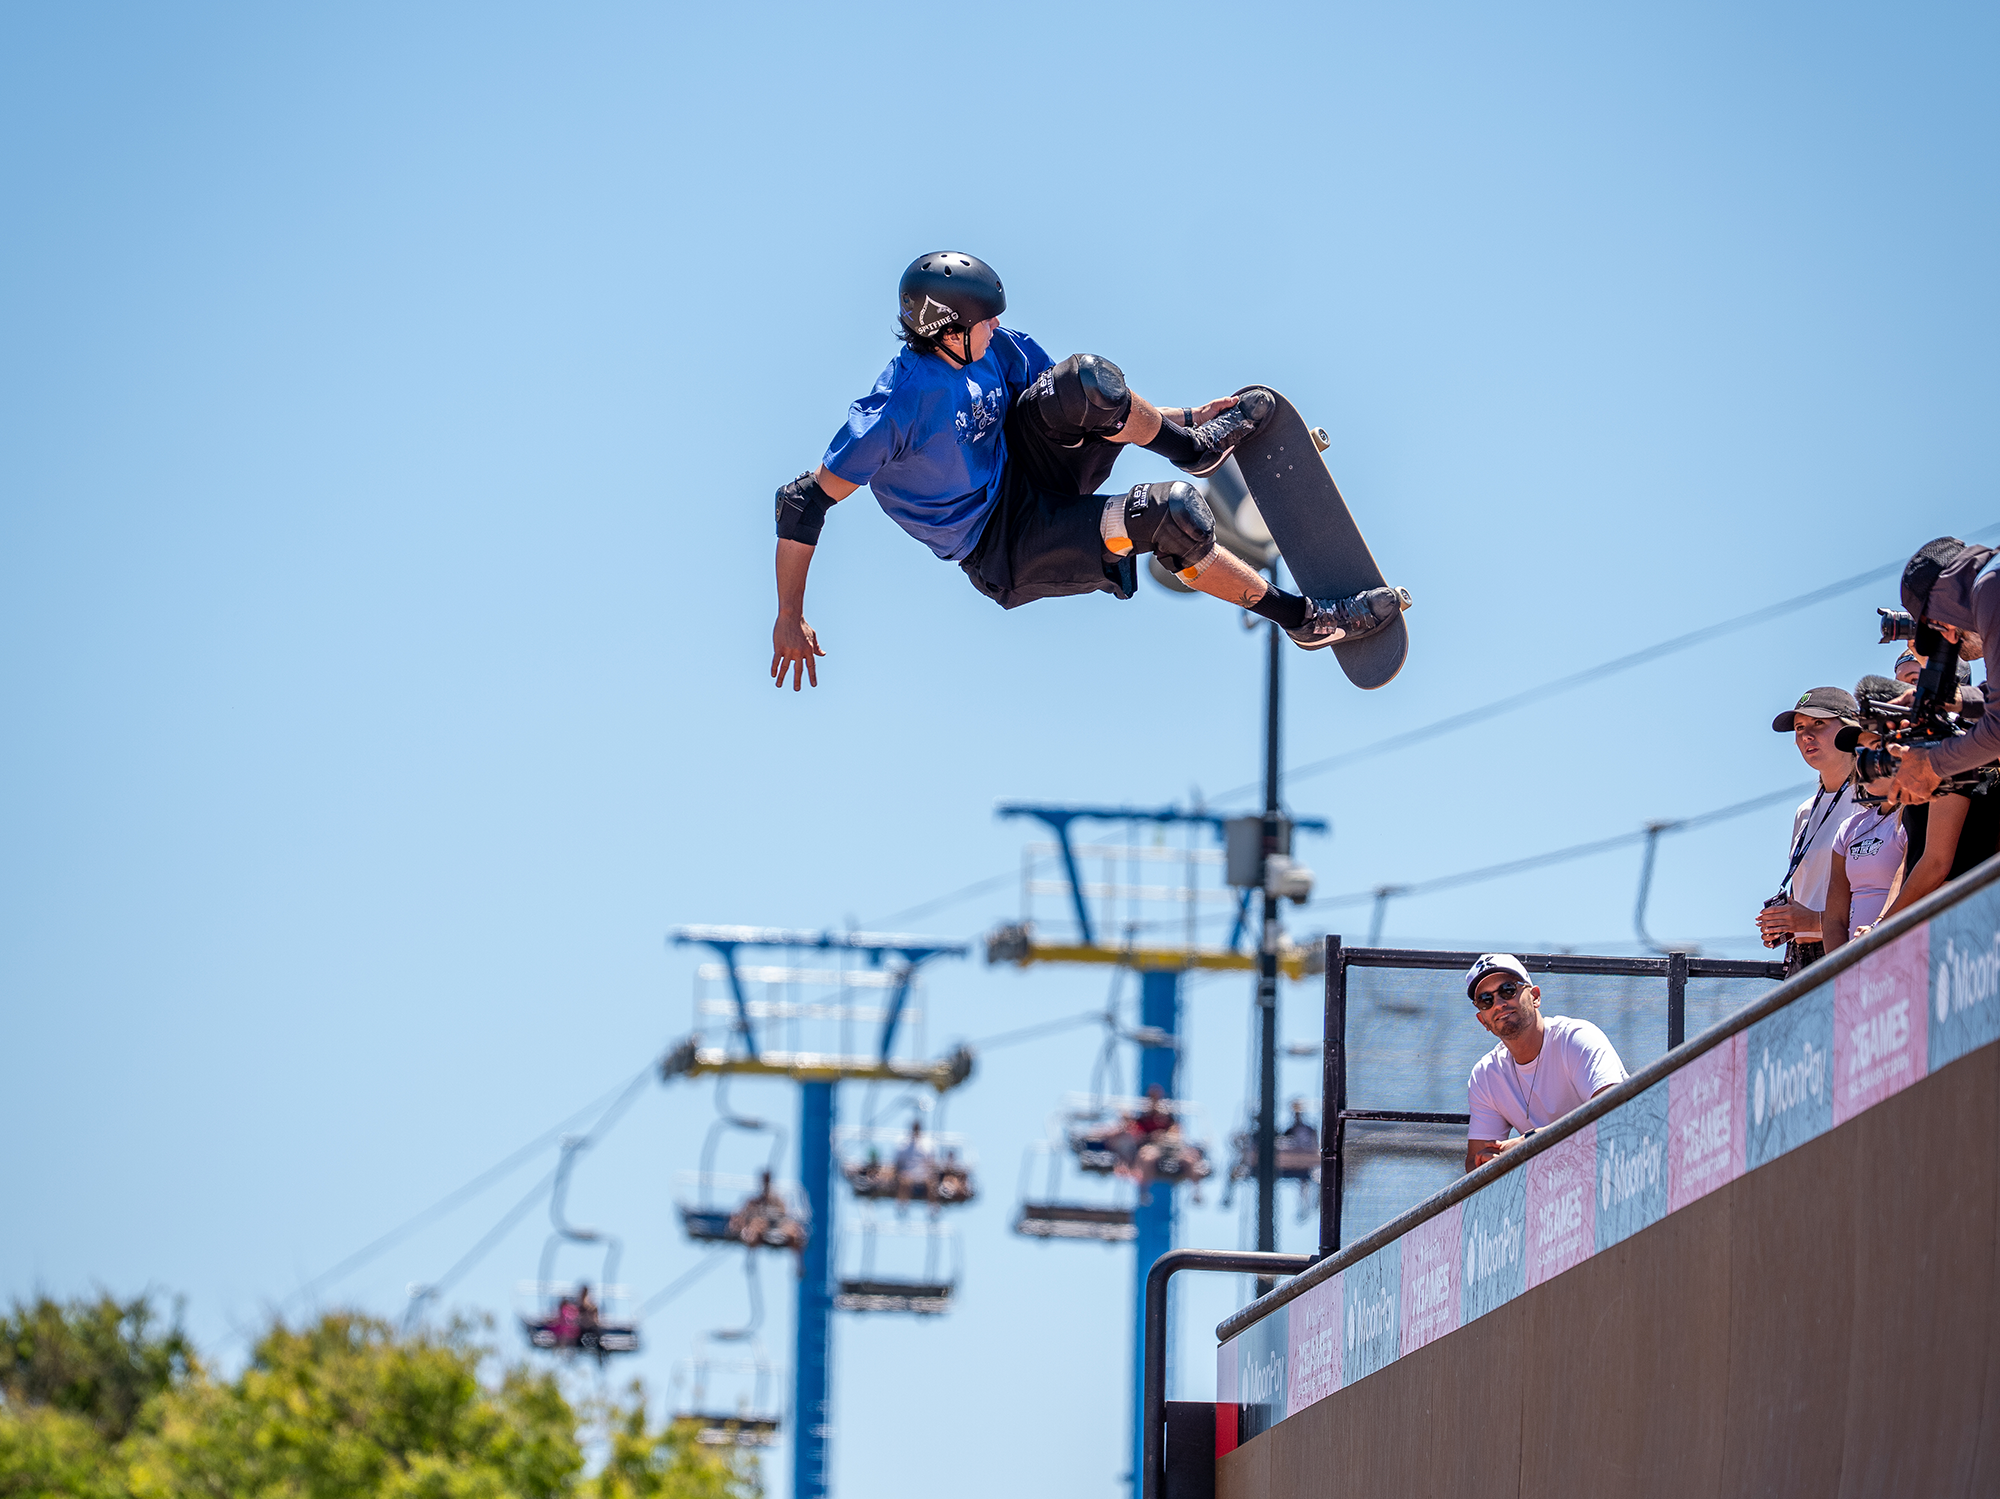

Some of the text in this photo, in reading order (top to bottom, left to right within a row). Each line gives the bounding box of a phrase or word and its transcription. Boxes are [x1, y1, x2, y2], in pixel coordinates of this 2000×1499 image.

[917, 315, 953, 335] SPITFIRE
[1133, 484, 1143, 507] 187
[1768, 1041, 1827, 1119] MoonPay
[1613, 1136, 1663, 1206] MoonPay
[1477, 1216, 1521, 1282] MoonPay
[1357, 1287, 1396, 1346] MoonPay
[1250, 1350, 1285, 1407] MoonPay
